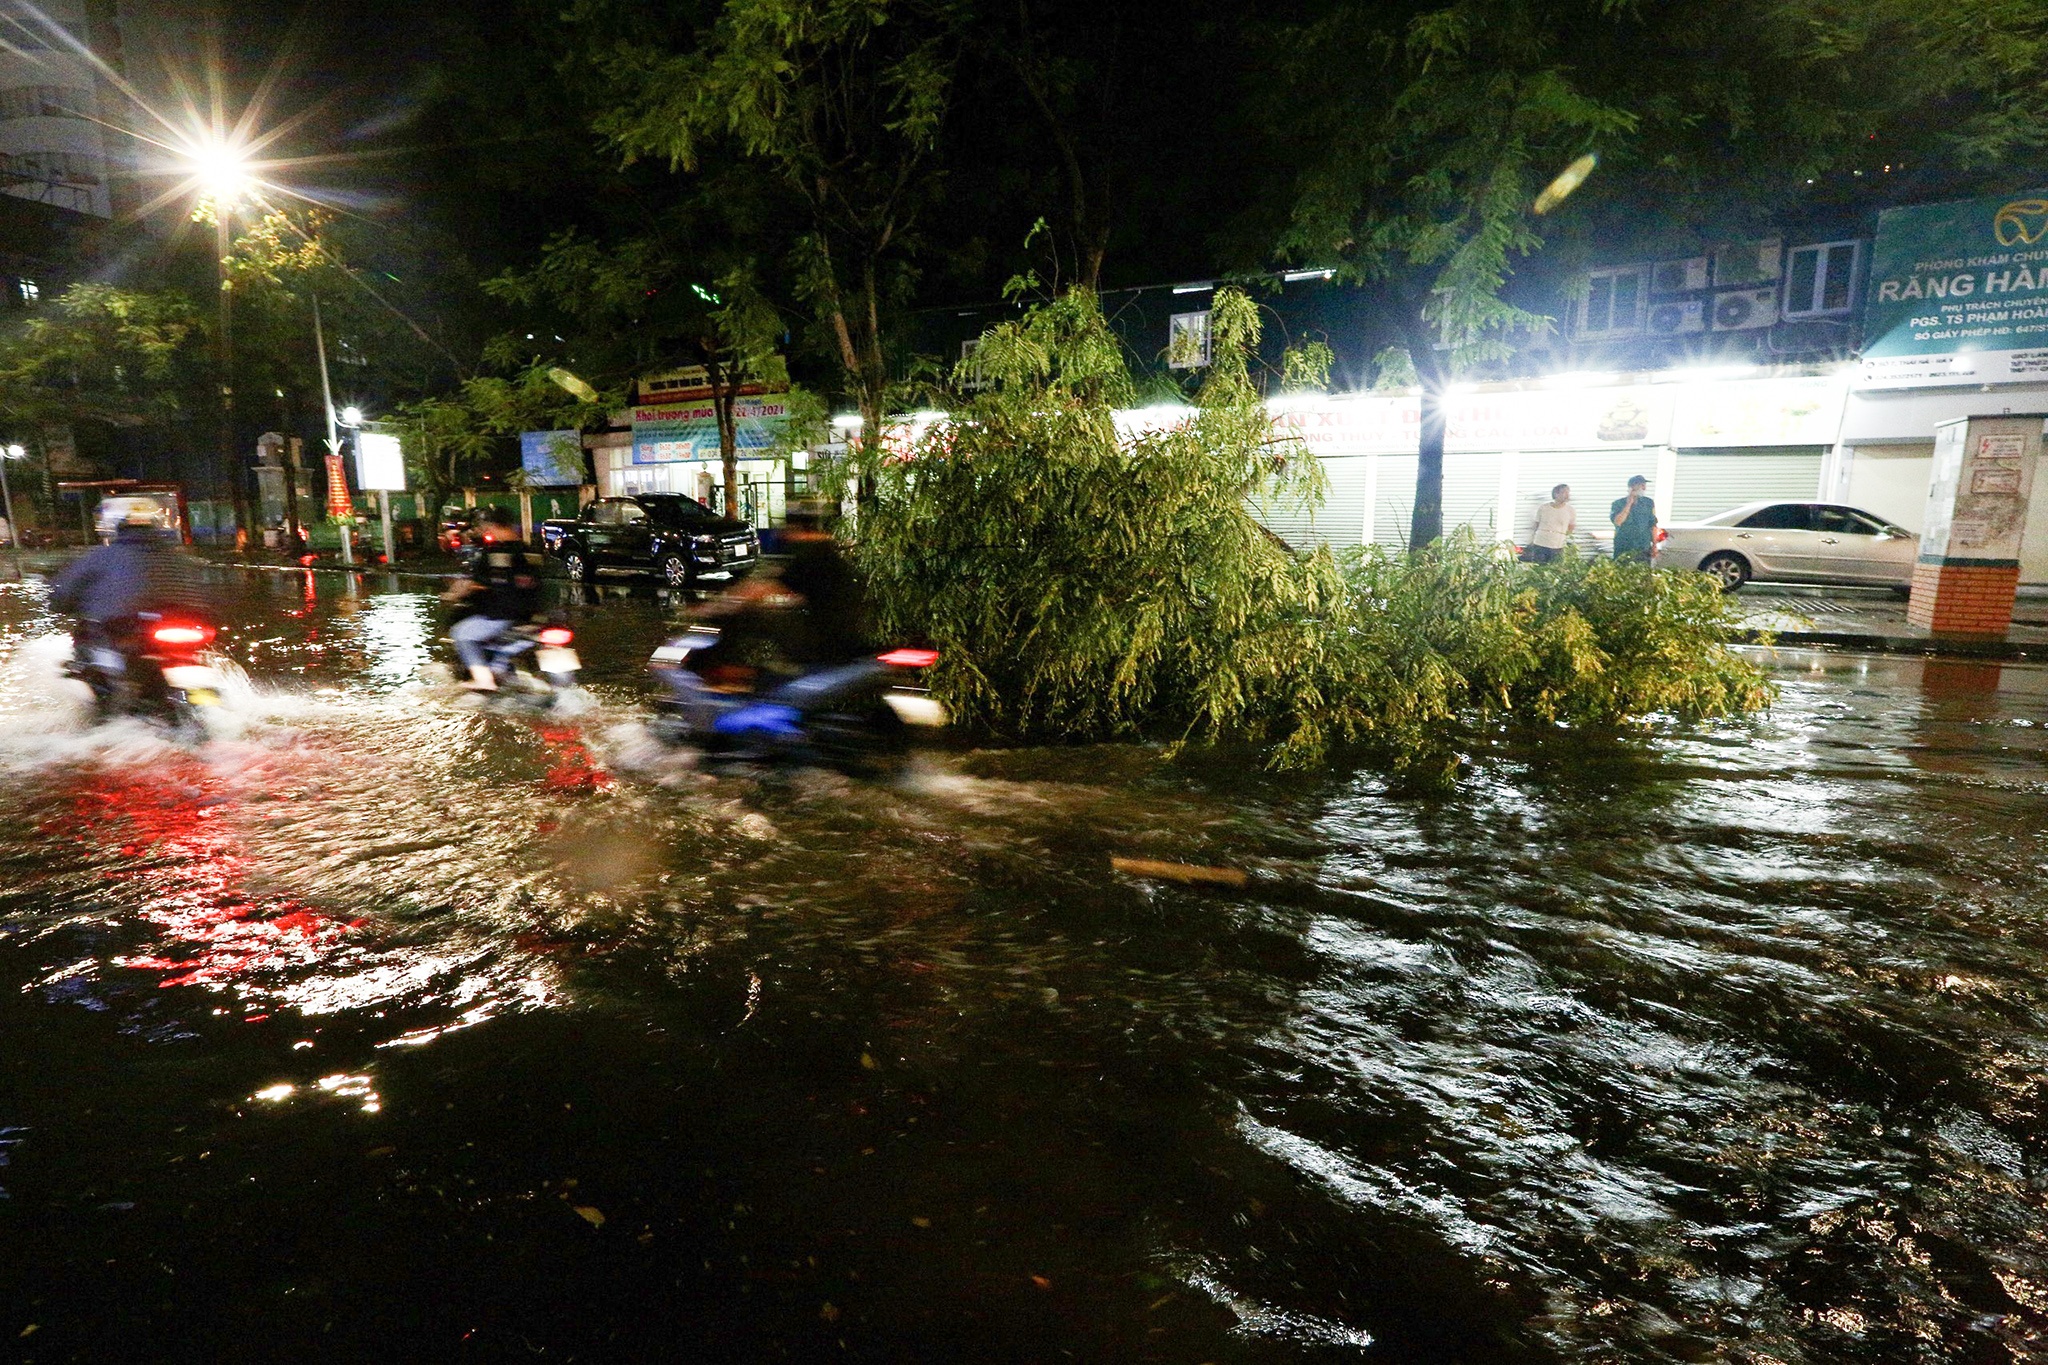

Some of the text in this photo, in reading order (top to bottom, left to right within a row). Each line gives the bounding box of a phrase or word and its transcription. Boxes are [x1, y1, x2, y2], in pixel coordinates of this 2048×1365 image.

[1878, 274, 1974, 302] RĂNG
[1910, 316, 1942, 328] PGS.
[1946, 314, 1964, 324] TS
[1966, 310, 2009, 324] PHẠM
[1961, 326, 1992, 338] PHÉP
